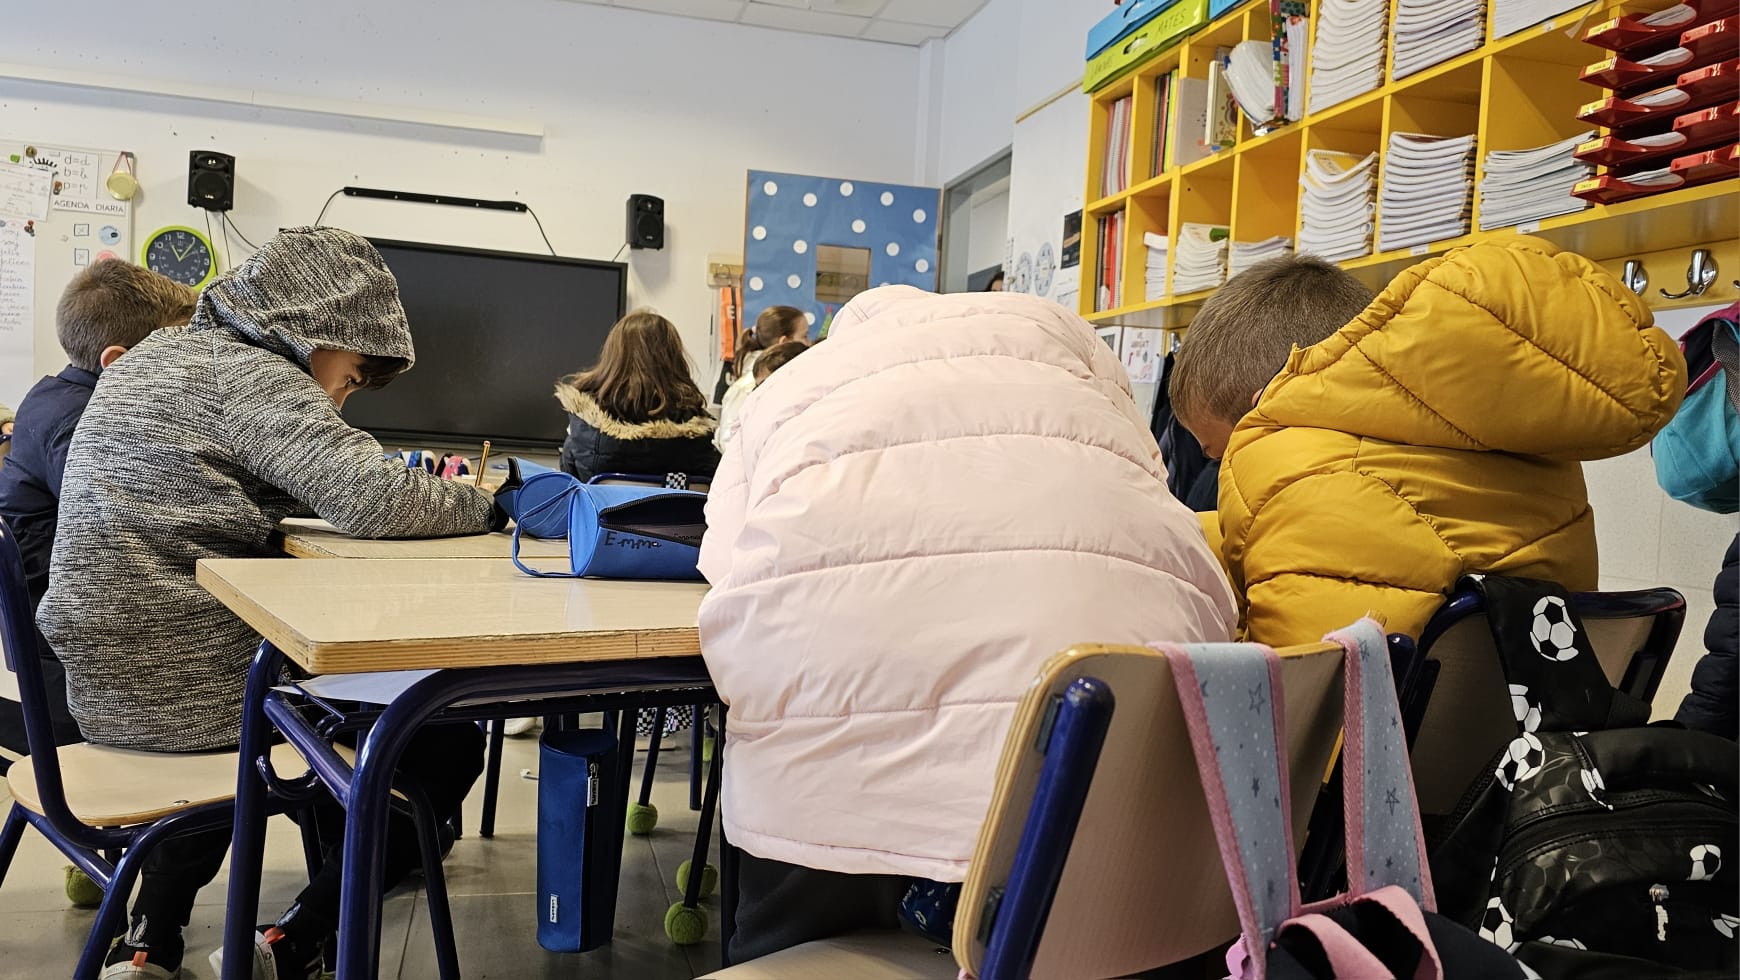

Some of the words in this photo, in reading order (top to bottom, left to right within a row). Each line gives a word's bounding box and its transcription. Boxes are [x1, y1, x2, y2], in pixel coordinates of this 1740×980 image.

[54, 200, 90, 210] AGENDA
[95, 203, 124, 212] DIARIA
[164, 233, 172, 241] 11
[176, 231, 186, 241] 12
[154, 241, 164, 249] 10
[199, 245, 207, 254] 2
[203, 257, 210, 266] 3
[604, 531, 661, 549] Emma
